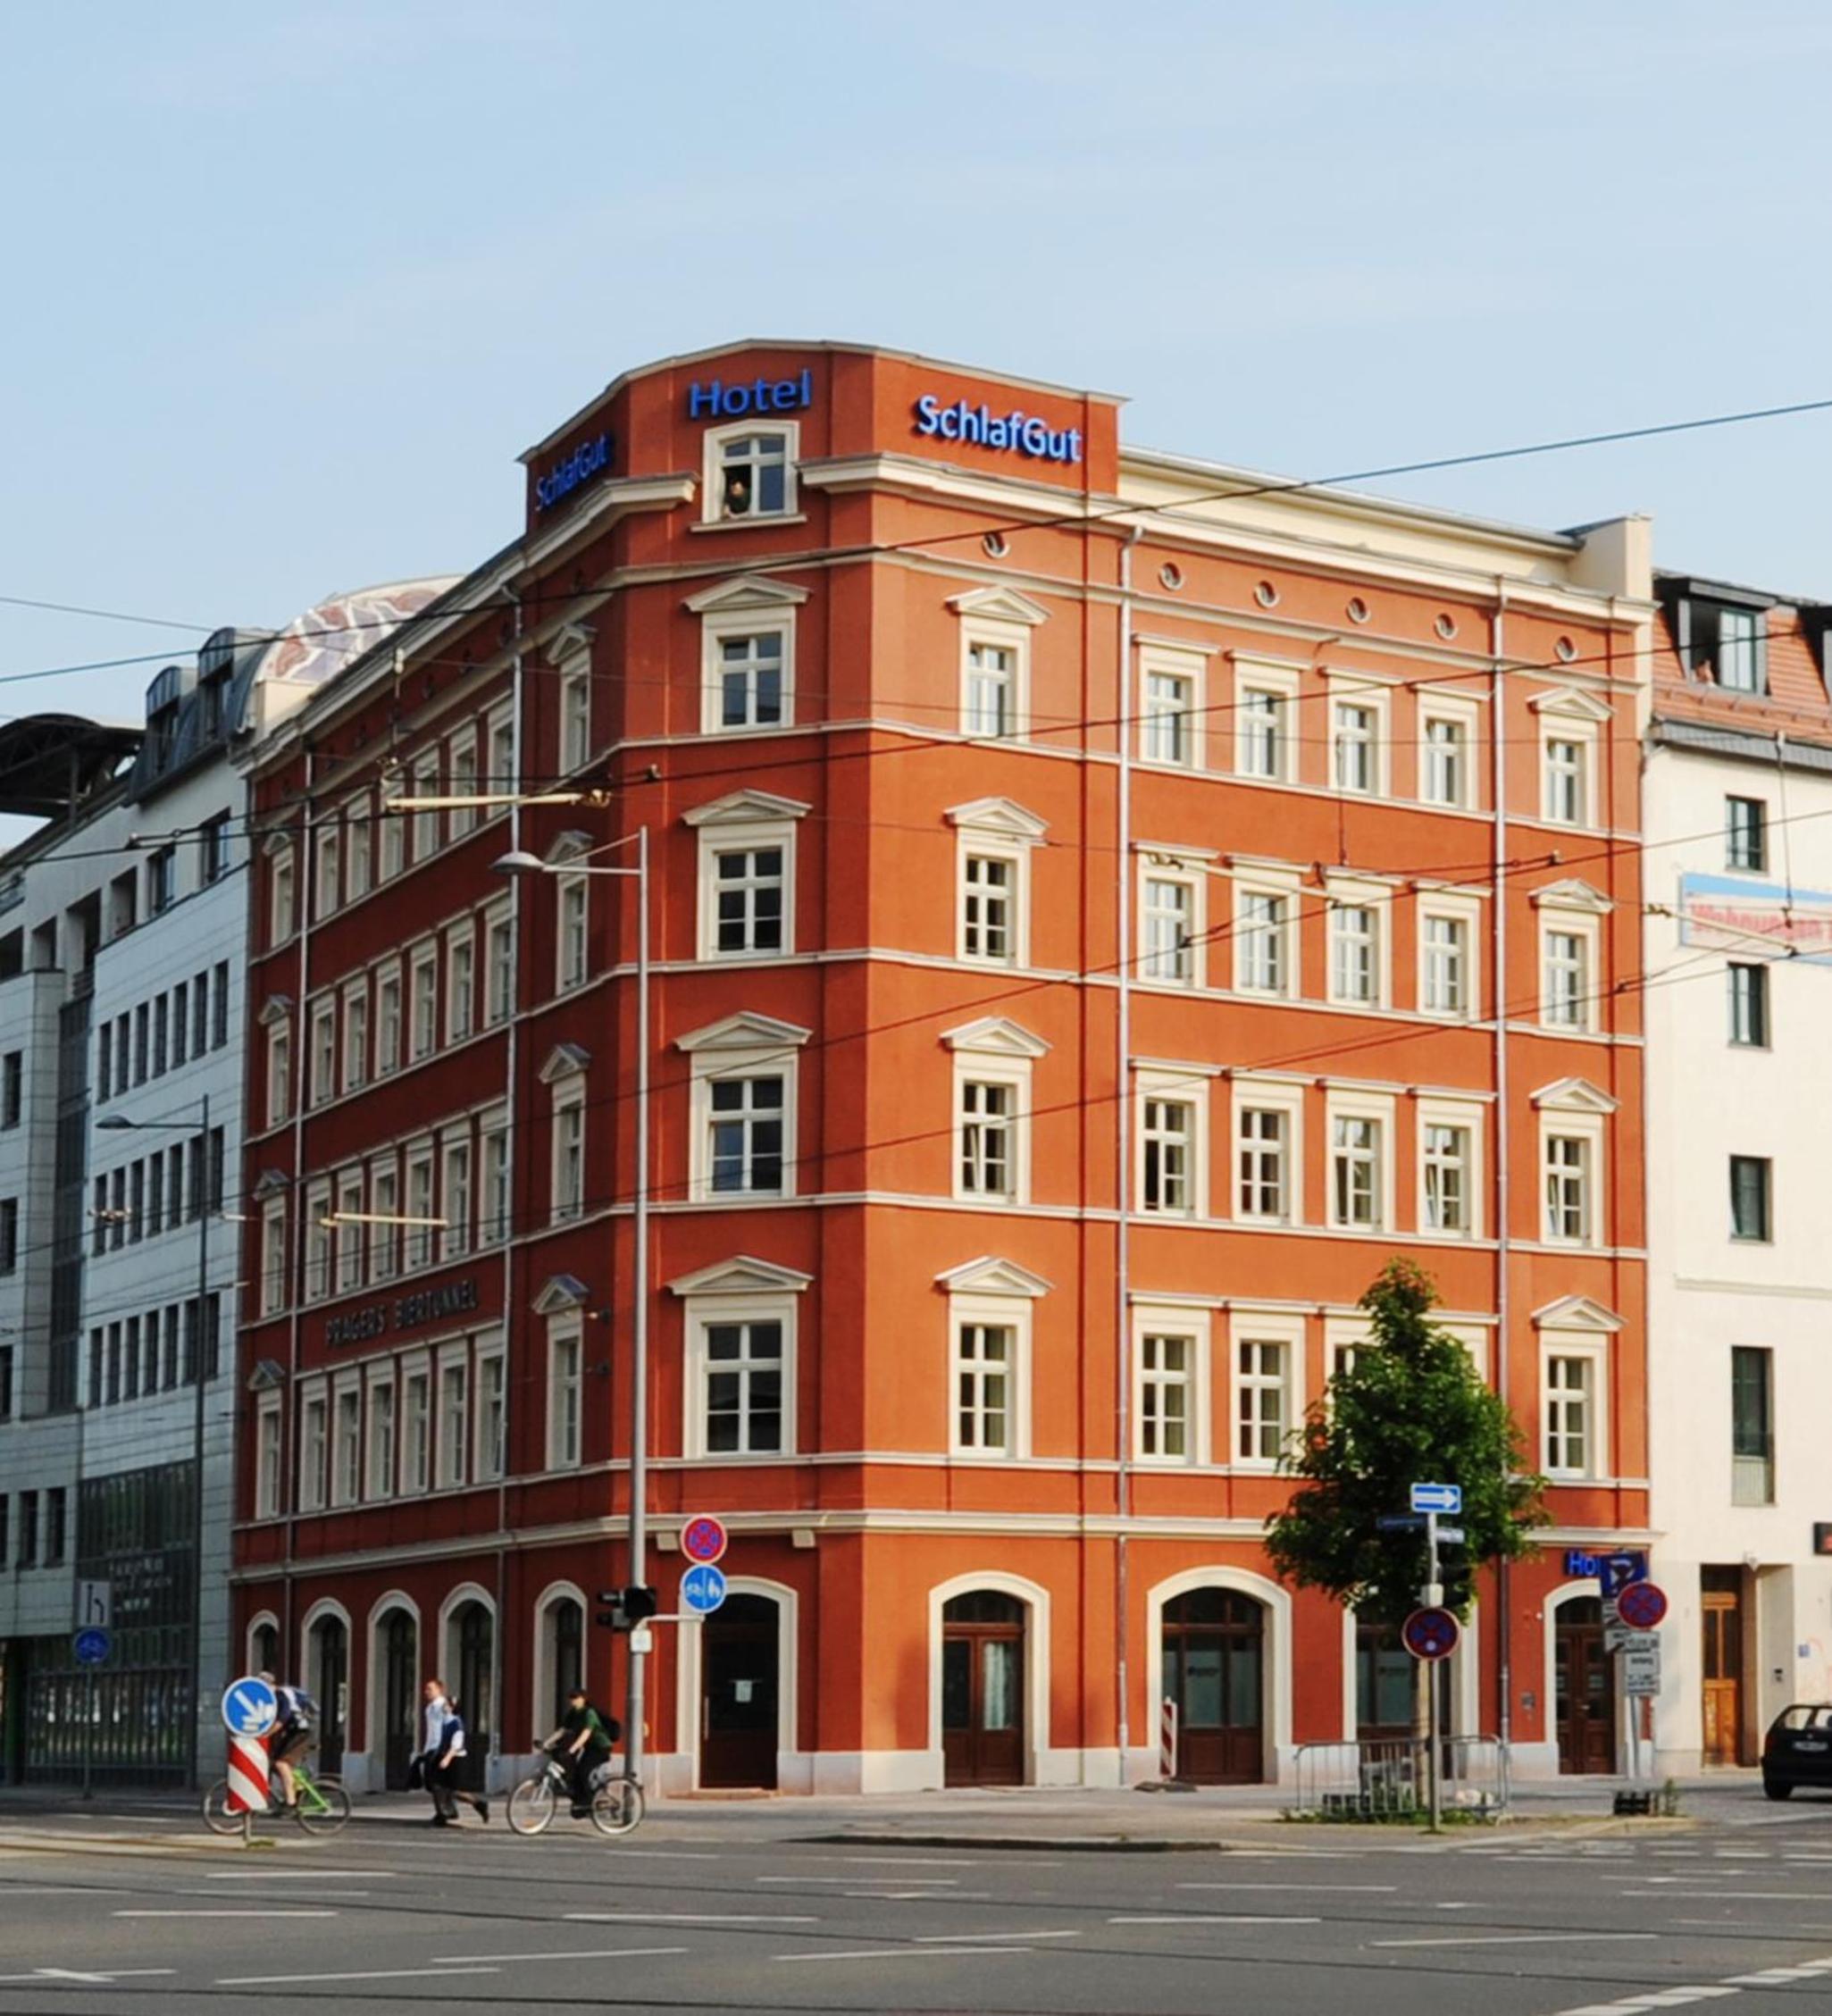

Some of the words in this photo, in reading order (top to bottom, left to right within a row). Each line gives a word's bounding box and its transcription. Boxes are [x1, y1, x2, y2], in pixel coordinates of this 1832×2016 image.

[690, 367, 811, 419] Hotel
[915, 395, 1083, 464] SchlafGut
[535, 432, 611, 511] SchlafGut
